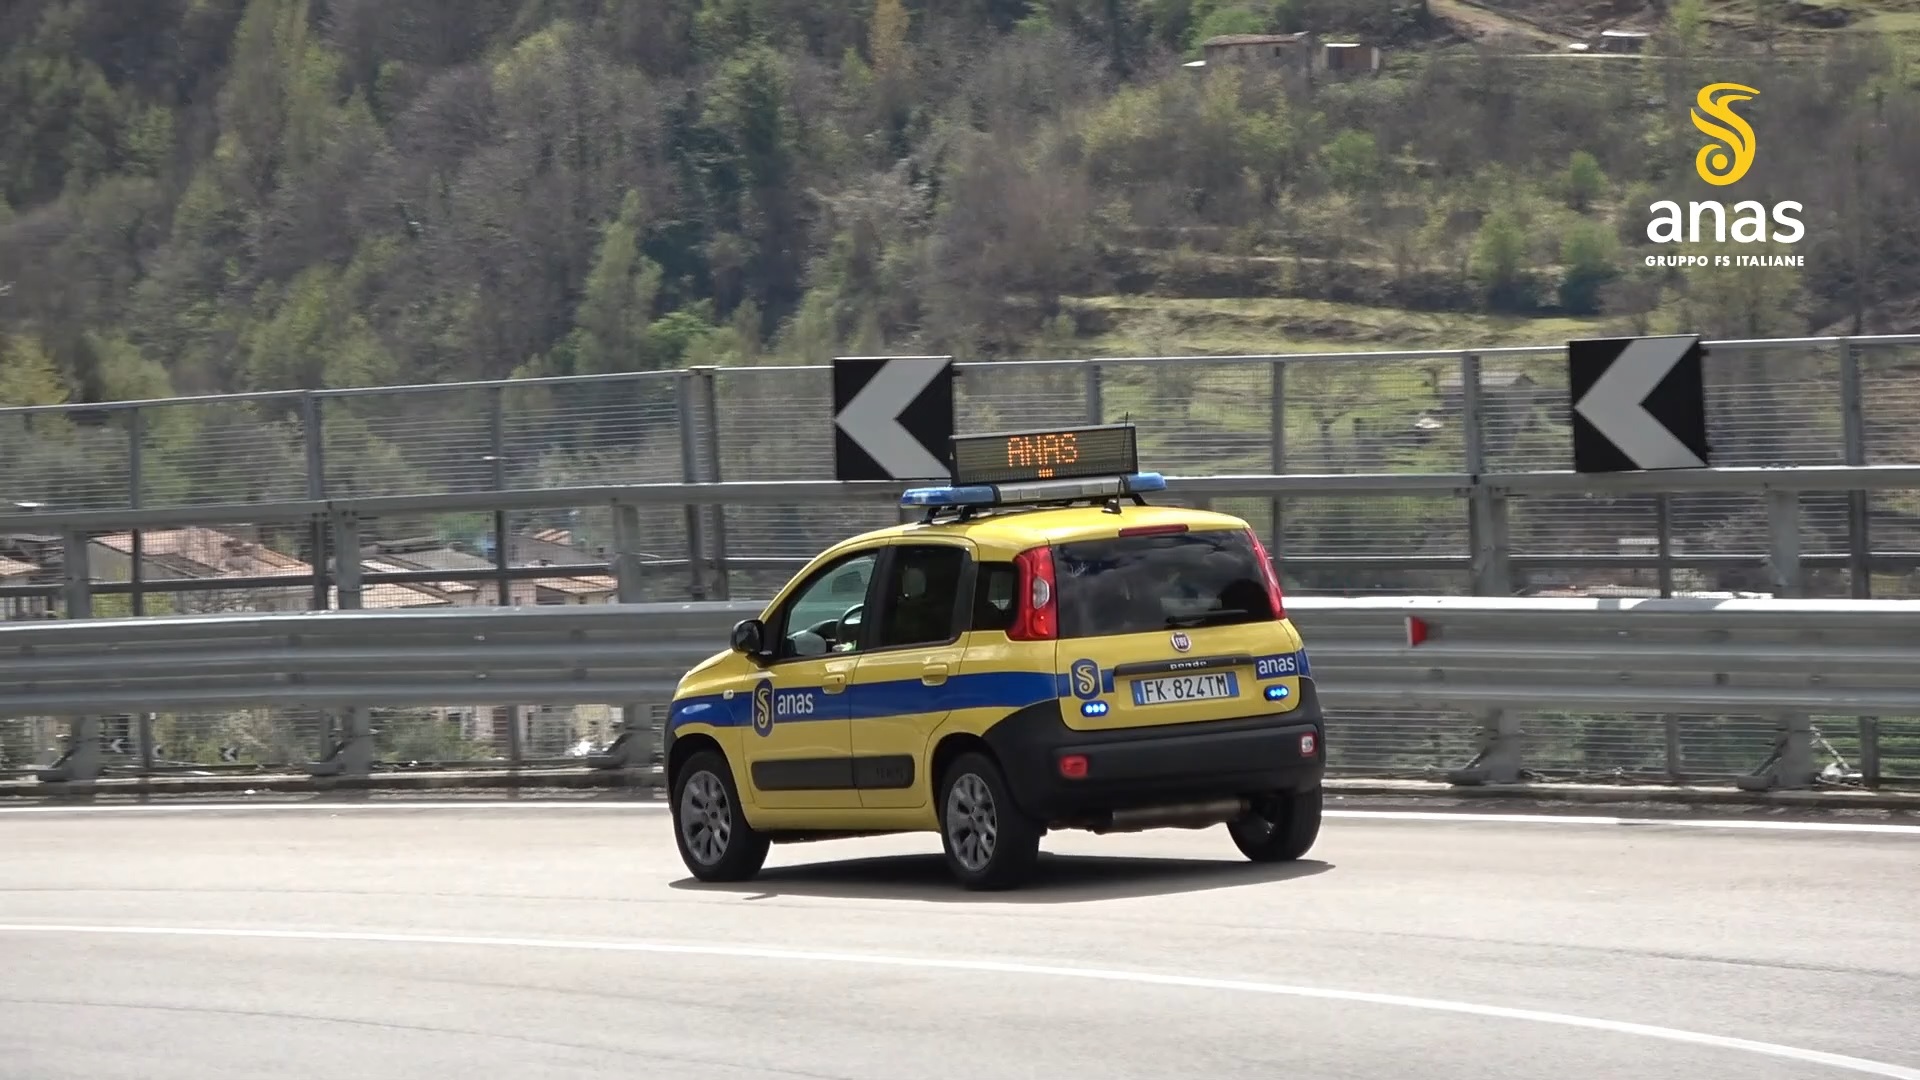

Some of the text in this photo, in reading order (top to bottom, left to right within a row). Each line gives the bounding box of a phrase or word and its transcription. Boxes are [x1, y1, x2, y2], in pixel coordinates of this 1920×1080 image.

[1007, 433, 1078, 467] ANAS
[1258, 656, 1296, 675] anas
[777, 692, 814, 716] anas
